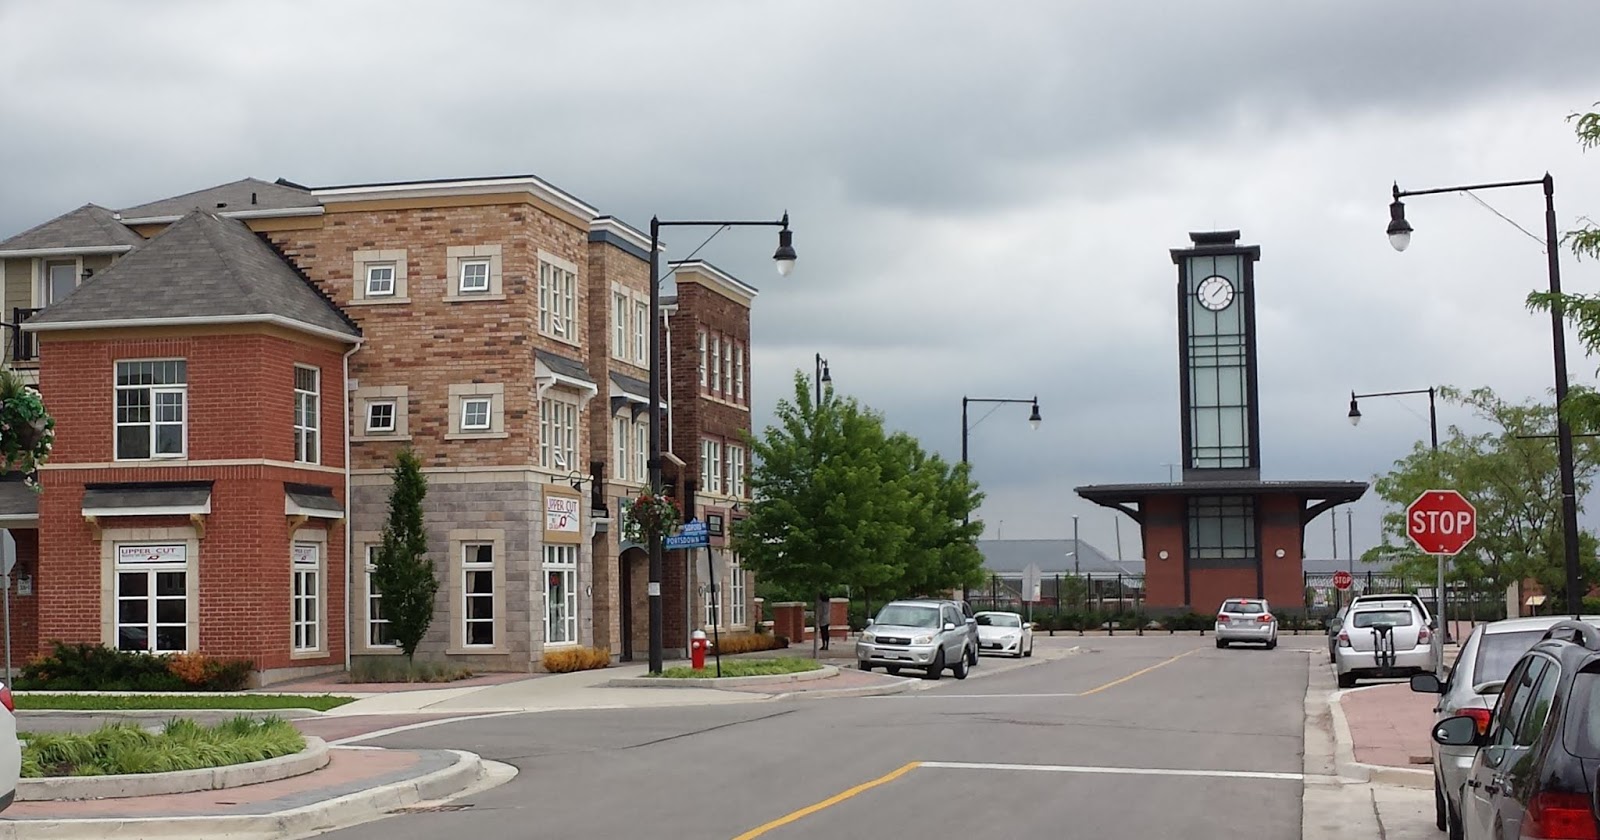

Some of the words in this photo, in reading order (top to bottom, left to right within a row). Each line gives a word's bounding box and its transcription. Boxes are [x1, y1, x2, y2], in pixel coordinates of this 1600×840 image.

[566, 500, 577, 512] CUT
[1412, 510, 1471, 534] STOP
[666, 536, 700, 545] PORTSDOWN
[1334, 576, 1351, 584] STOP
